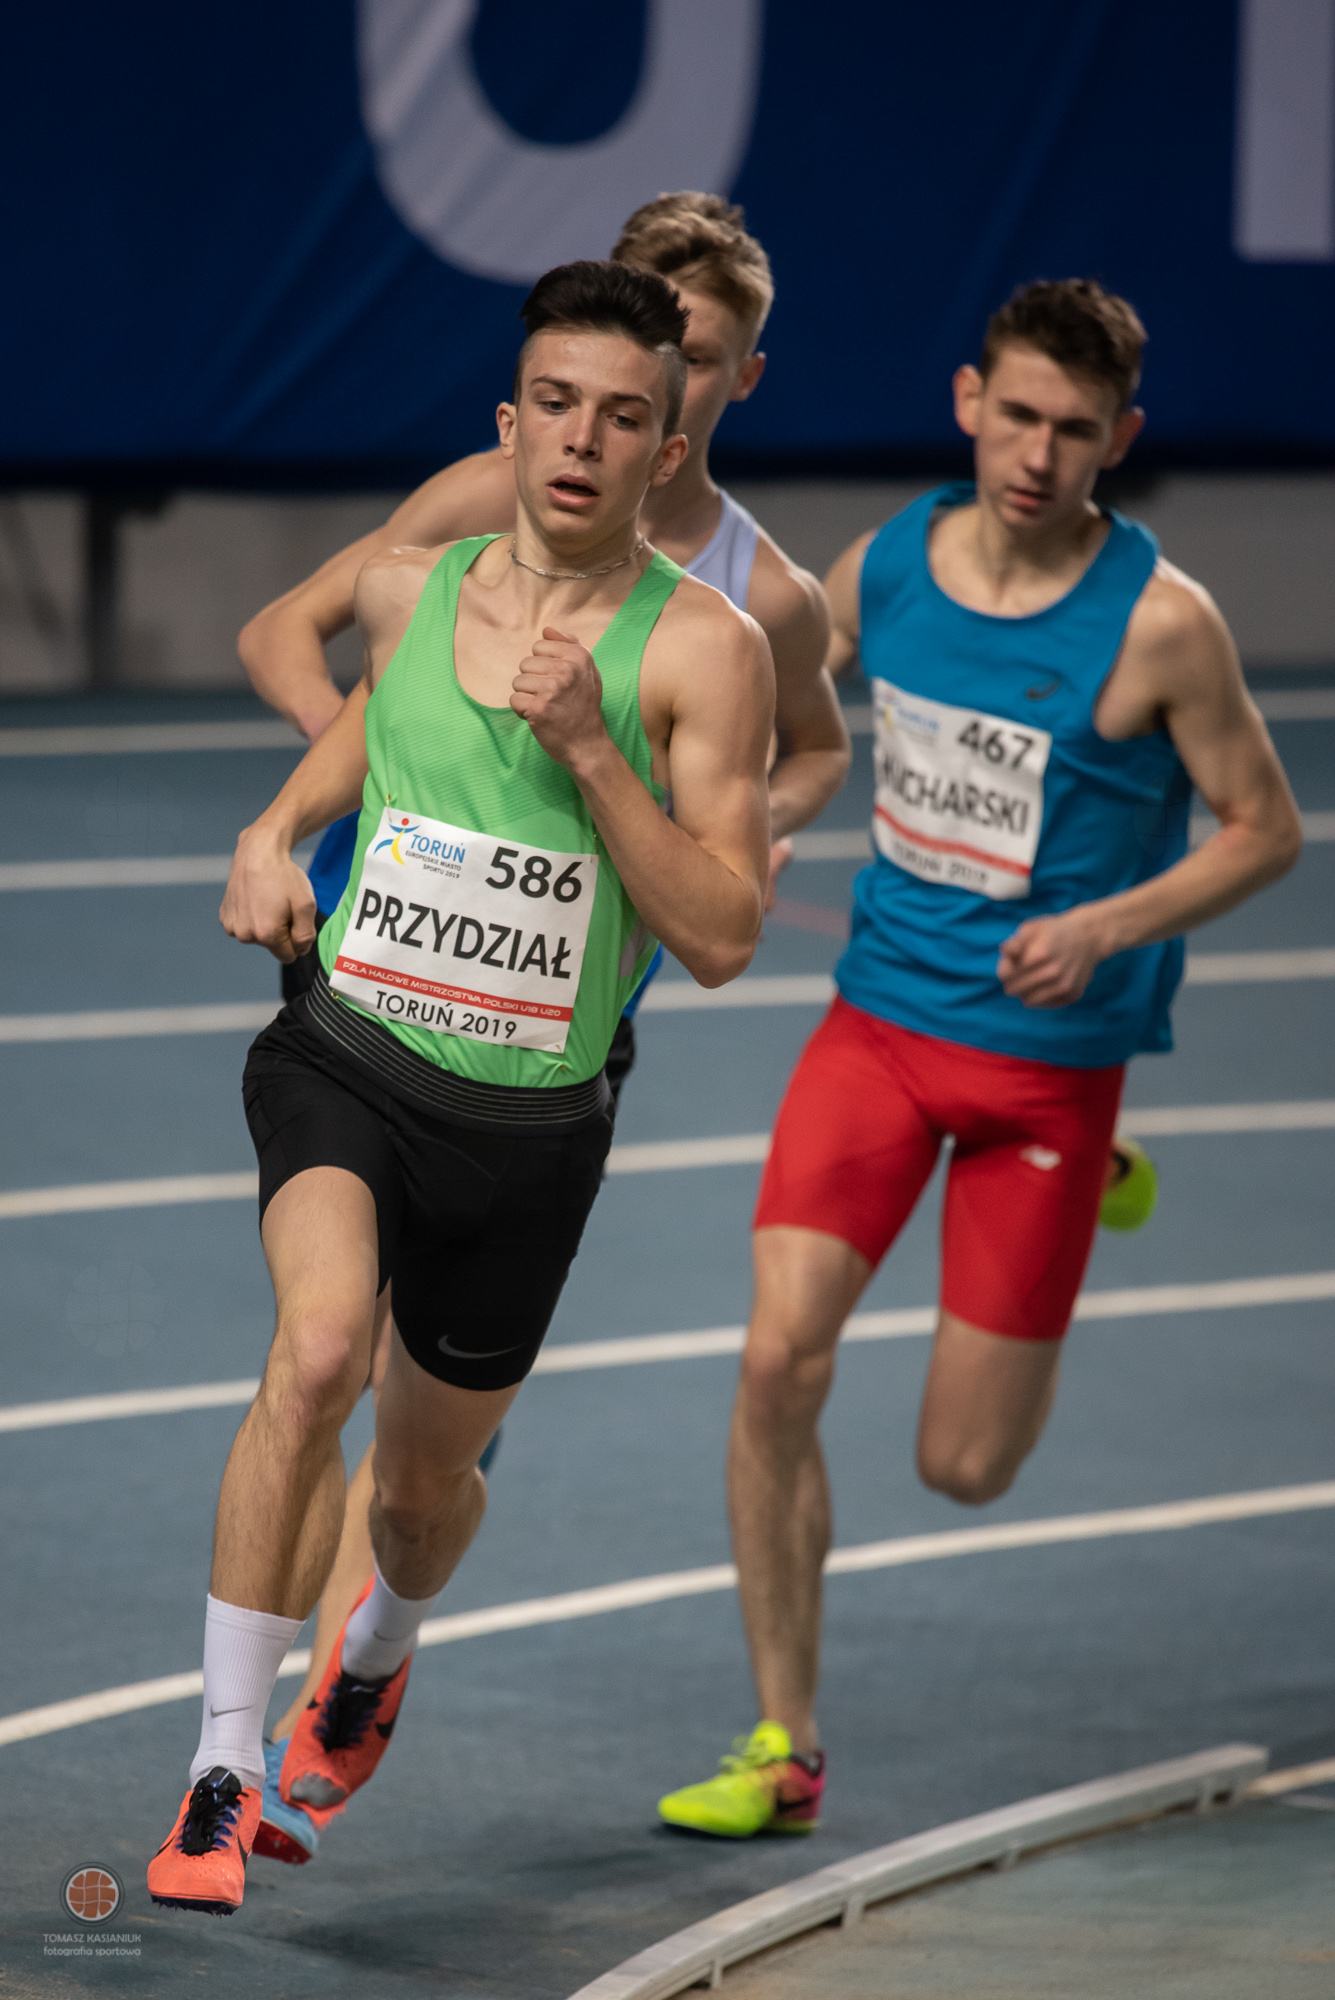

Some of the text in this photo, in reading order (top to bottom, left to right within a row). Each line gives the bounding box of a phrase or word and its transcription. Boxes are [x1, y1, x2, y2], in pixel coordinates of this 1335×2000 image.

[958, 719, 1035, 770] 467
[410, 834, 466, 863] TORUŃ
[422, 863, 460, 879] SPORTU 2019
[440, 858, 462, 871] MIASTO
[485, 846, 583, 903] 586
[355, 888, 571, 979] PRZYDZIAŁ
[342, 961, 562, 1017] PZLA HALOWE MISTRZOSTWA POLSKI U18 U20
[376, 990, 517, 1039] TORUŃ 2019
